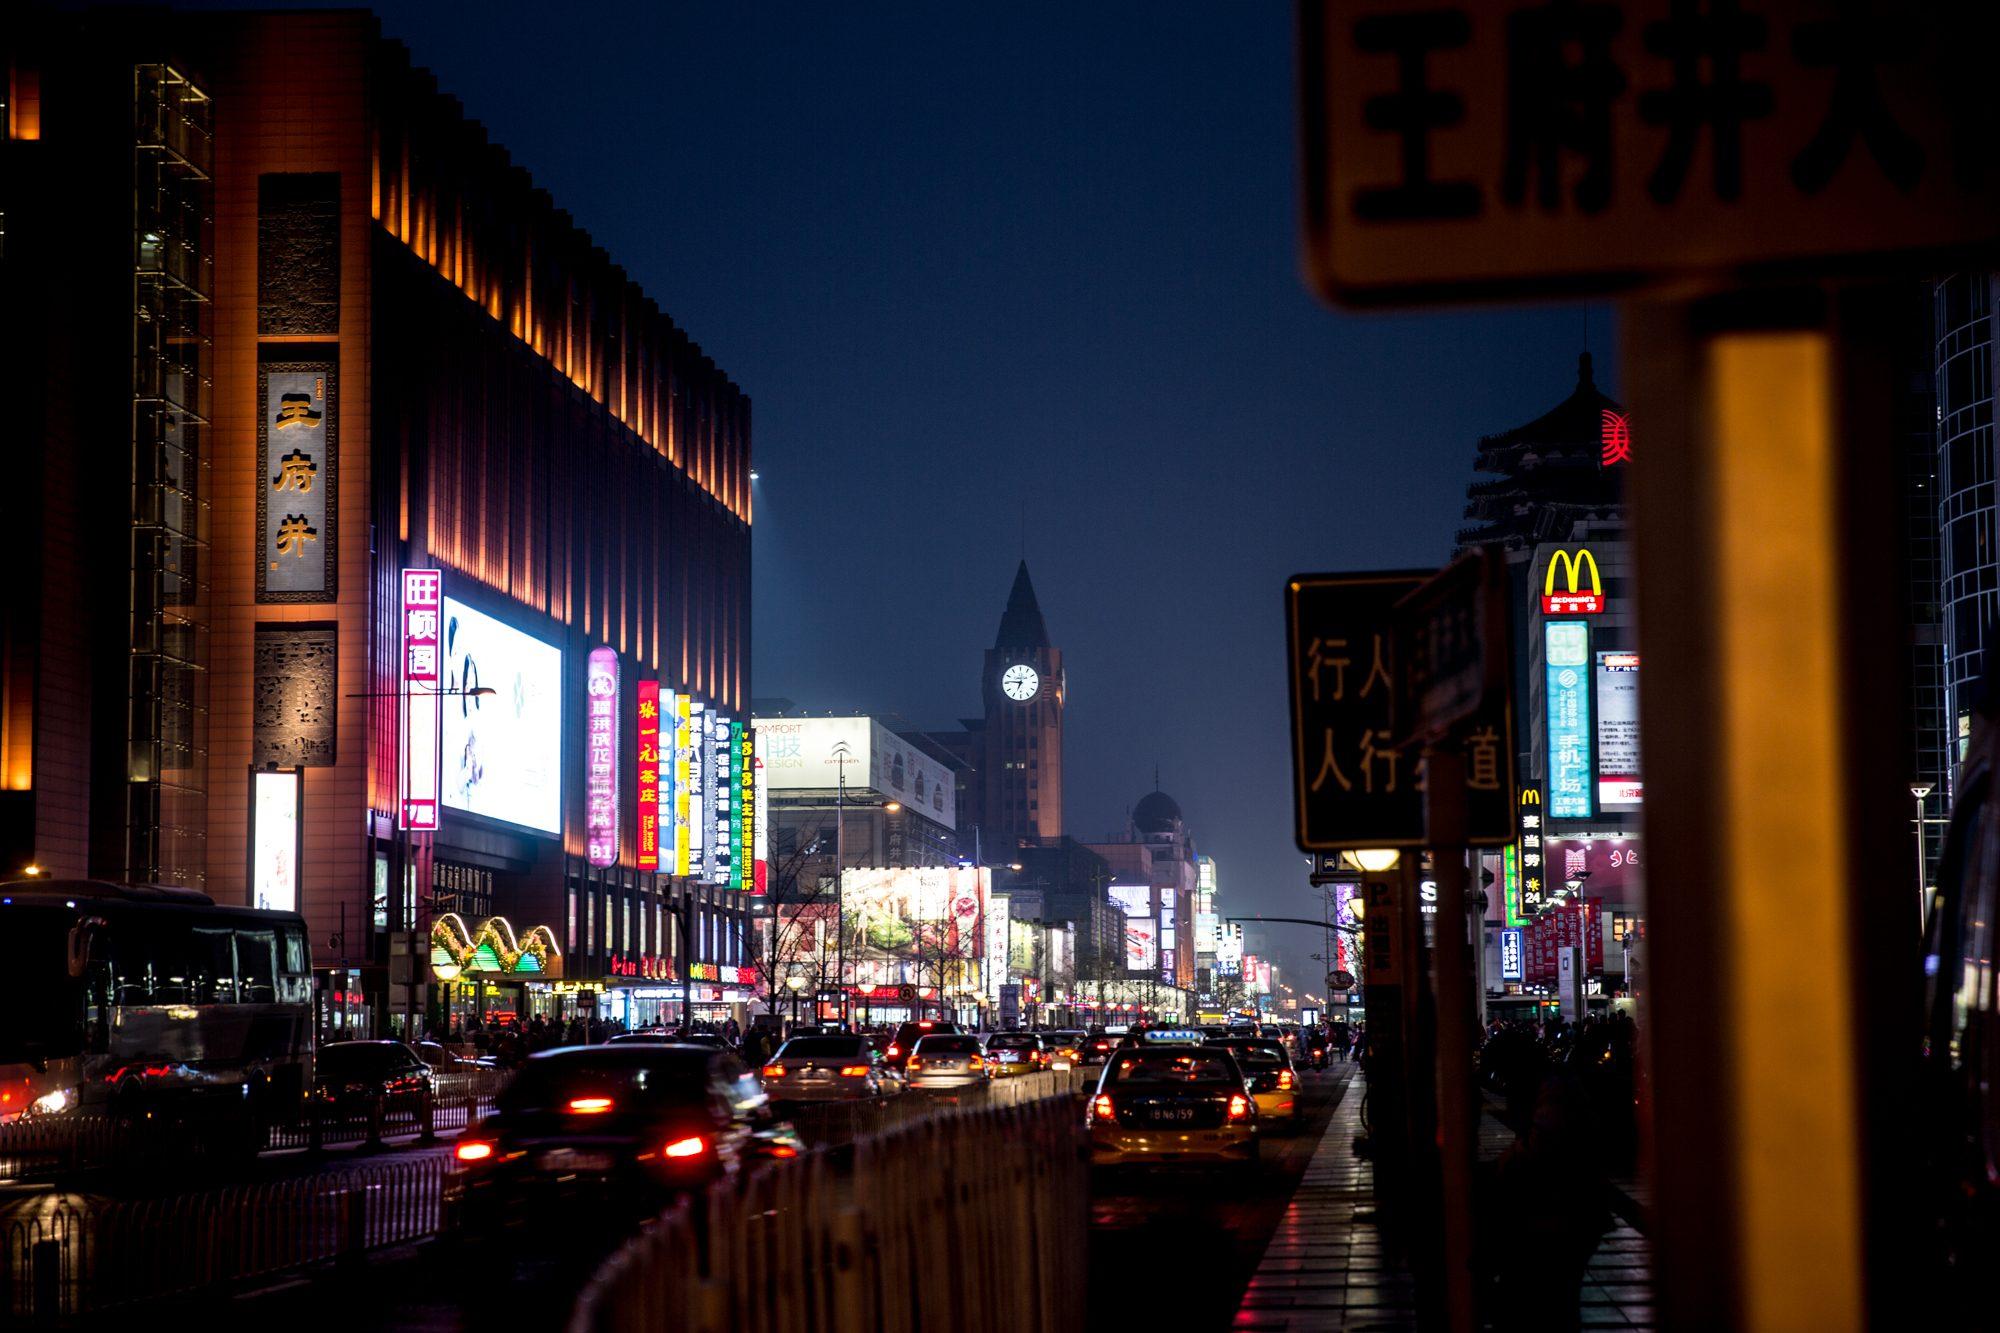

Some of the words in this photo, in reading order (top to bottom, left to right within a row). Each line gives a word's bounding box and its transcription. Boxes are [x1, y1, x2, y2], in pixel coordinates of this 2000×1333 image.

[273, 394, 322, 558] 王府井
[1550, 603, 1597, 612] 麦当劳
[406, 574, 438, 675] 旺顺阁
[1566, 690, 1578, 727] 中国移动
[755, 725, 802, 735] OMFORT
[767, 758, 803, 769] ESIGN
[1558, 734, 1581, 793] 手机广场
[590, 844, 612, 859] B1
[1523, 815, 1541, 867] 麦当劳
[1525, 891, 1541, 904] 24
